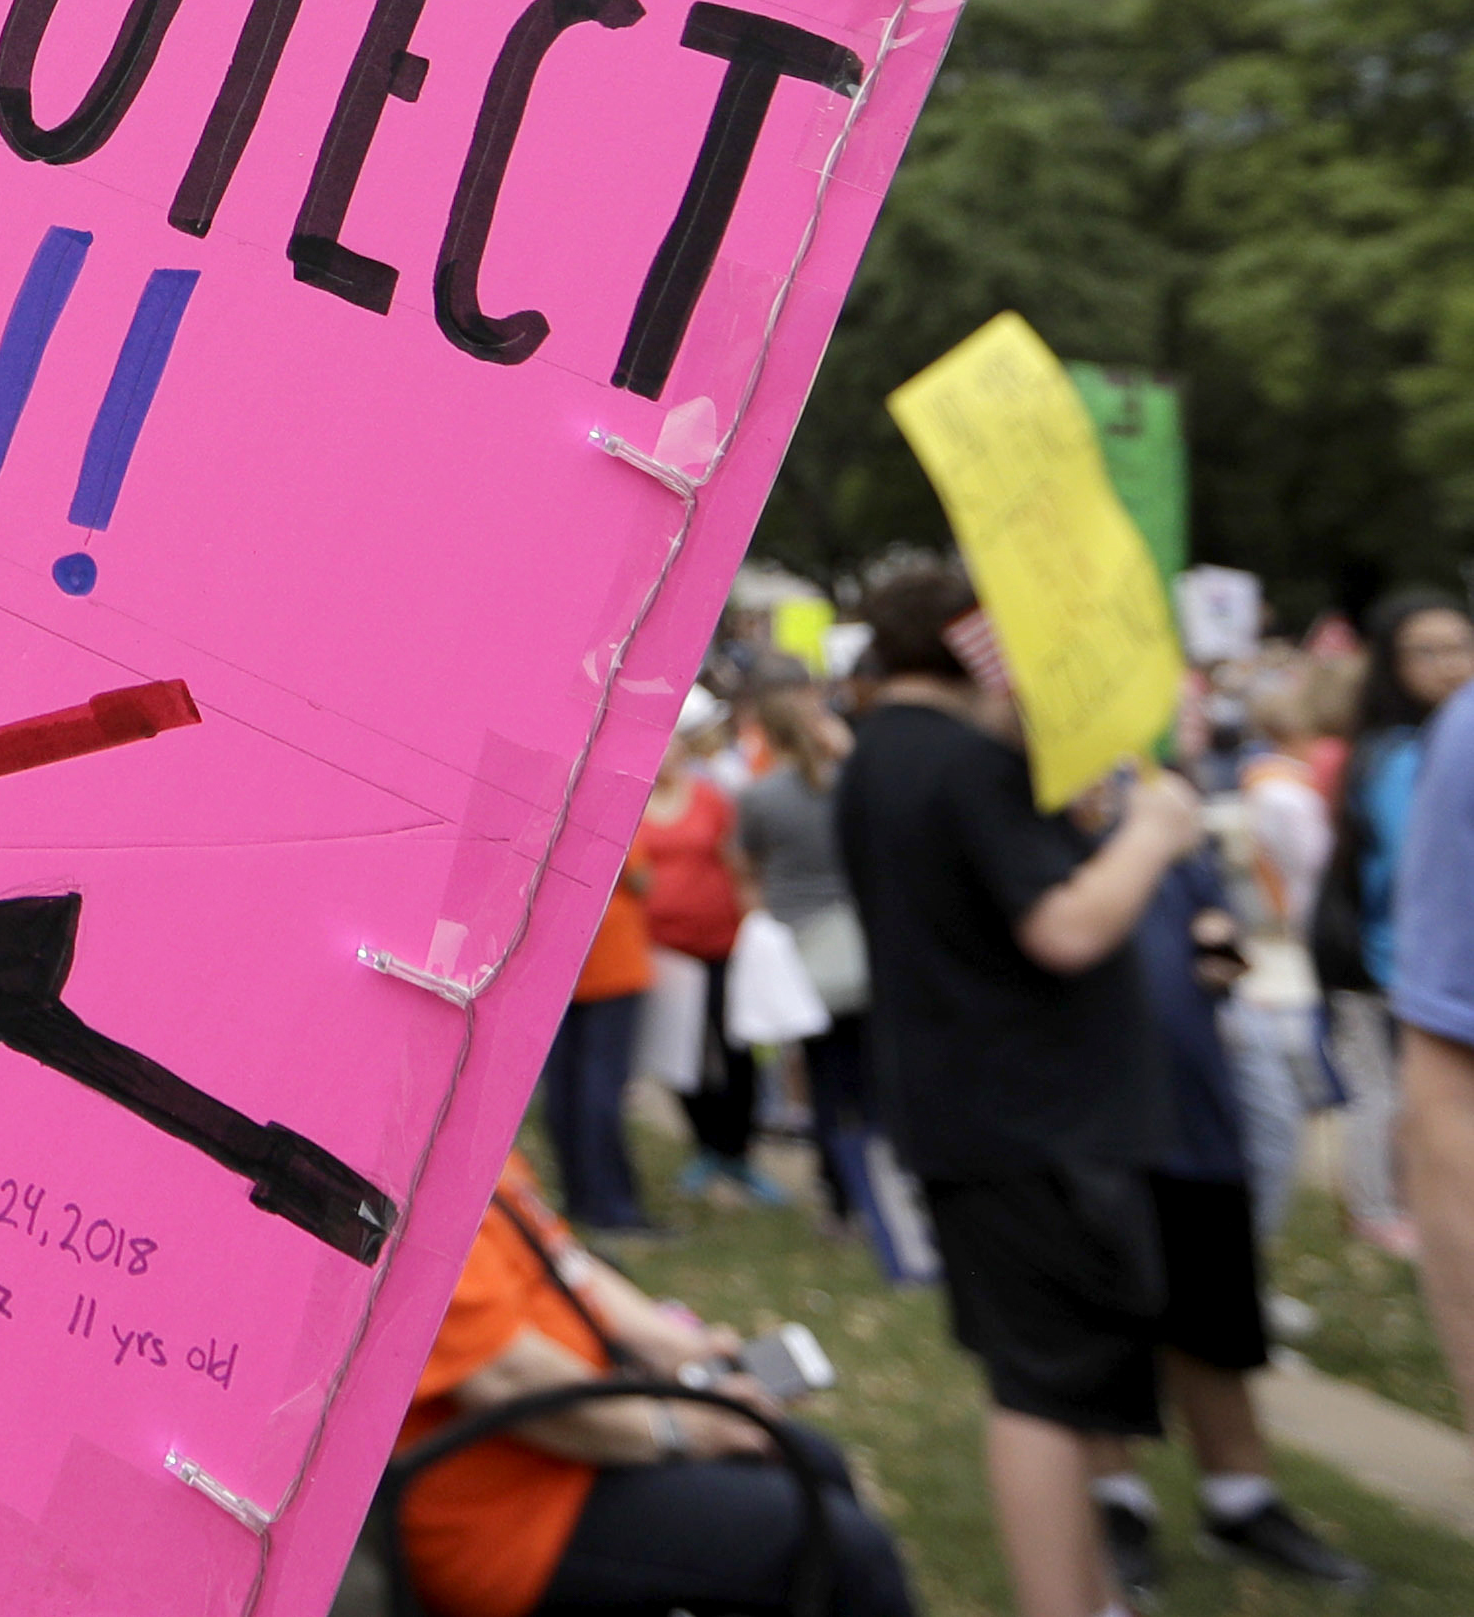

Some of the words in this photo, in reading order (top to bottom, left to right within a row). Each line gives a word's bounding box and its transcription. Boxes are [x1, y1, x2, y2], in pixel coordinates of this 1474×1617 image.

[67, 1293, 98, 1339] 11
[111, 1323, 168, 1367] yrs
[185, 1337, 240, 1391] old
